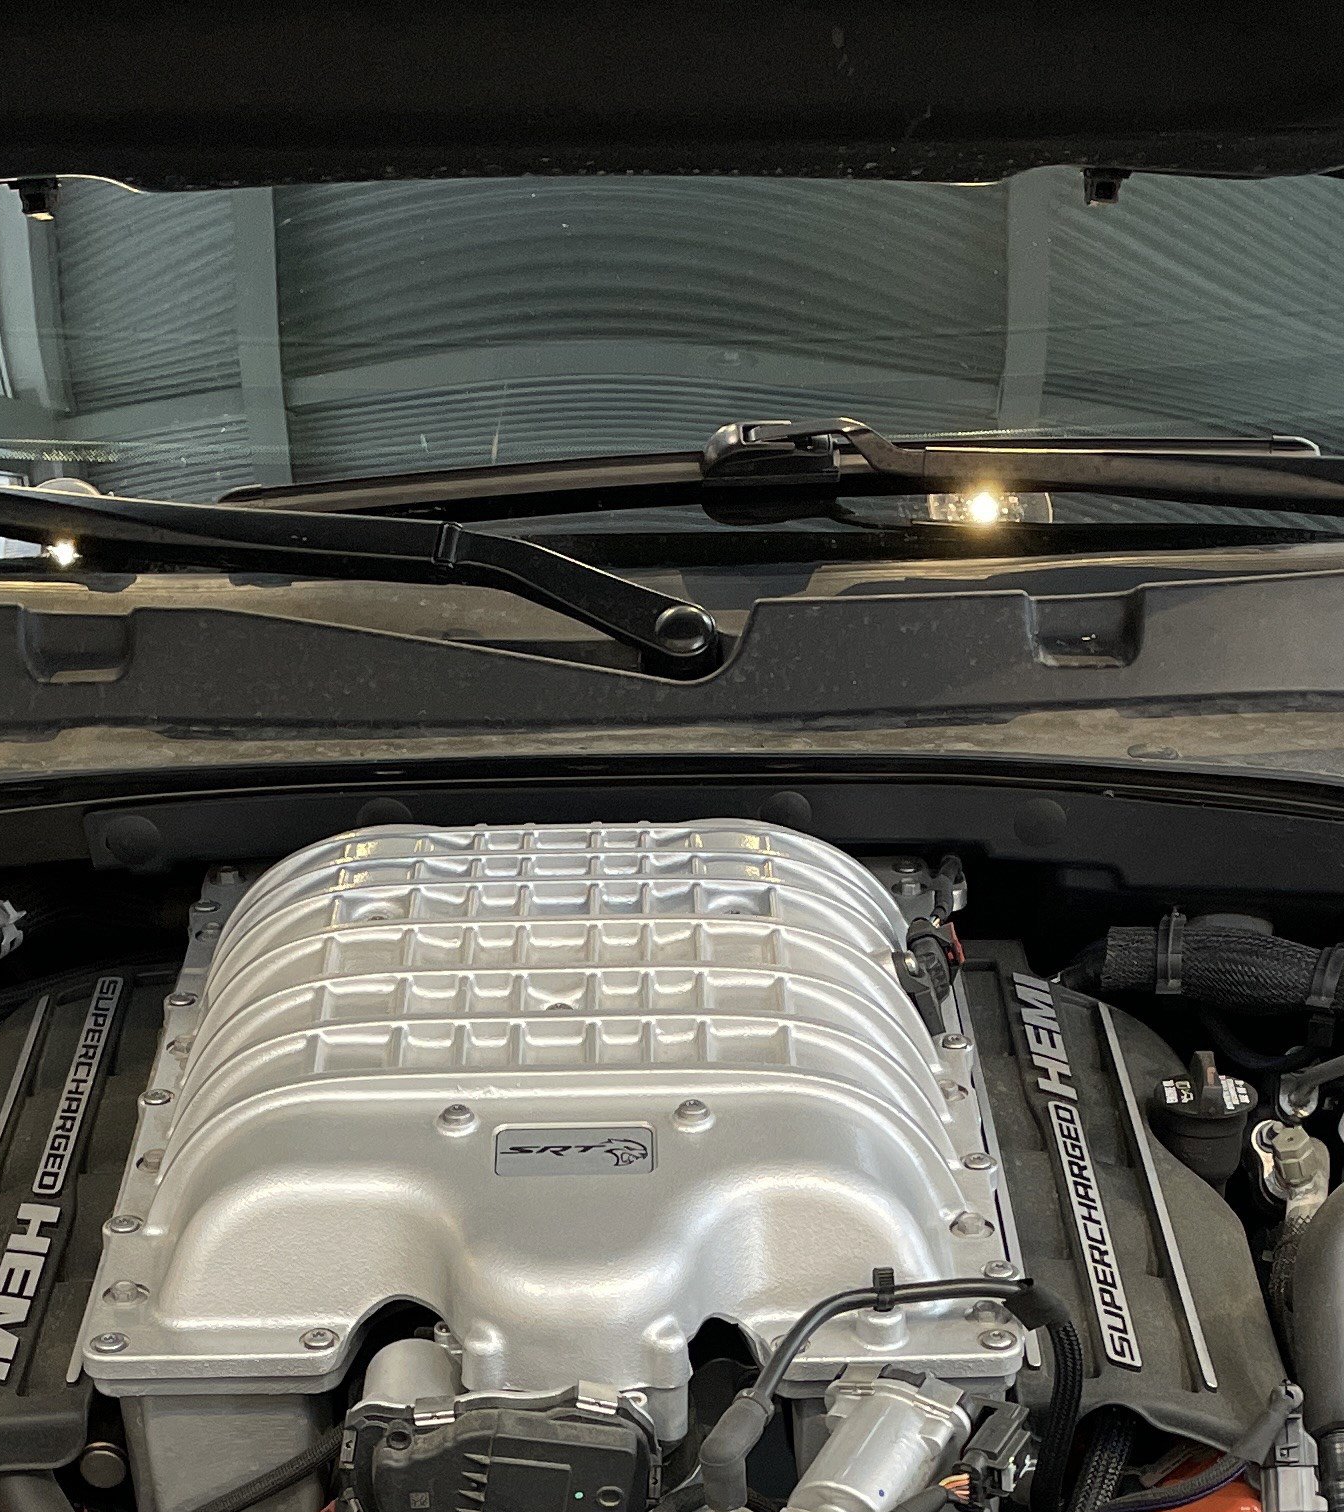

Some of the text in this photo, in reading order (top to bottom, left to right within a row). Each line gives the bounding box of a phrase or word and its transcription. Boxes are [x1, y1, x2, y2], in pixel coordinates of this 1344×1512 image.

[37, 978, 121, 1191] SUPERCHARGED
[1012, 972, 1078, 1101] HEMI
[500, 1145, 608, 1156] SRT
[1052, 1103, 1139, 1363] SUPERCHARGED
